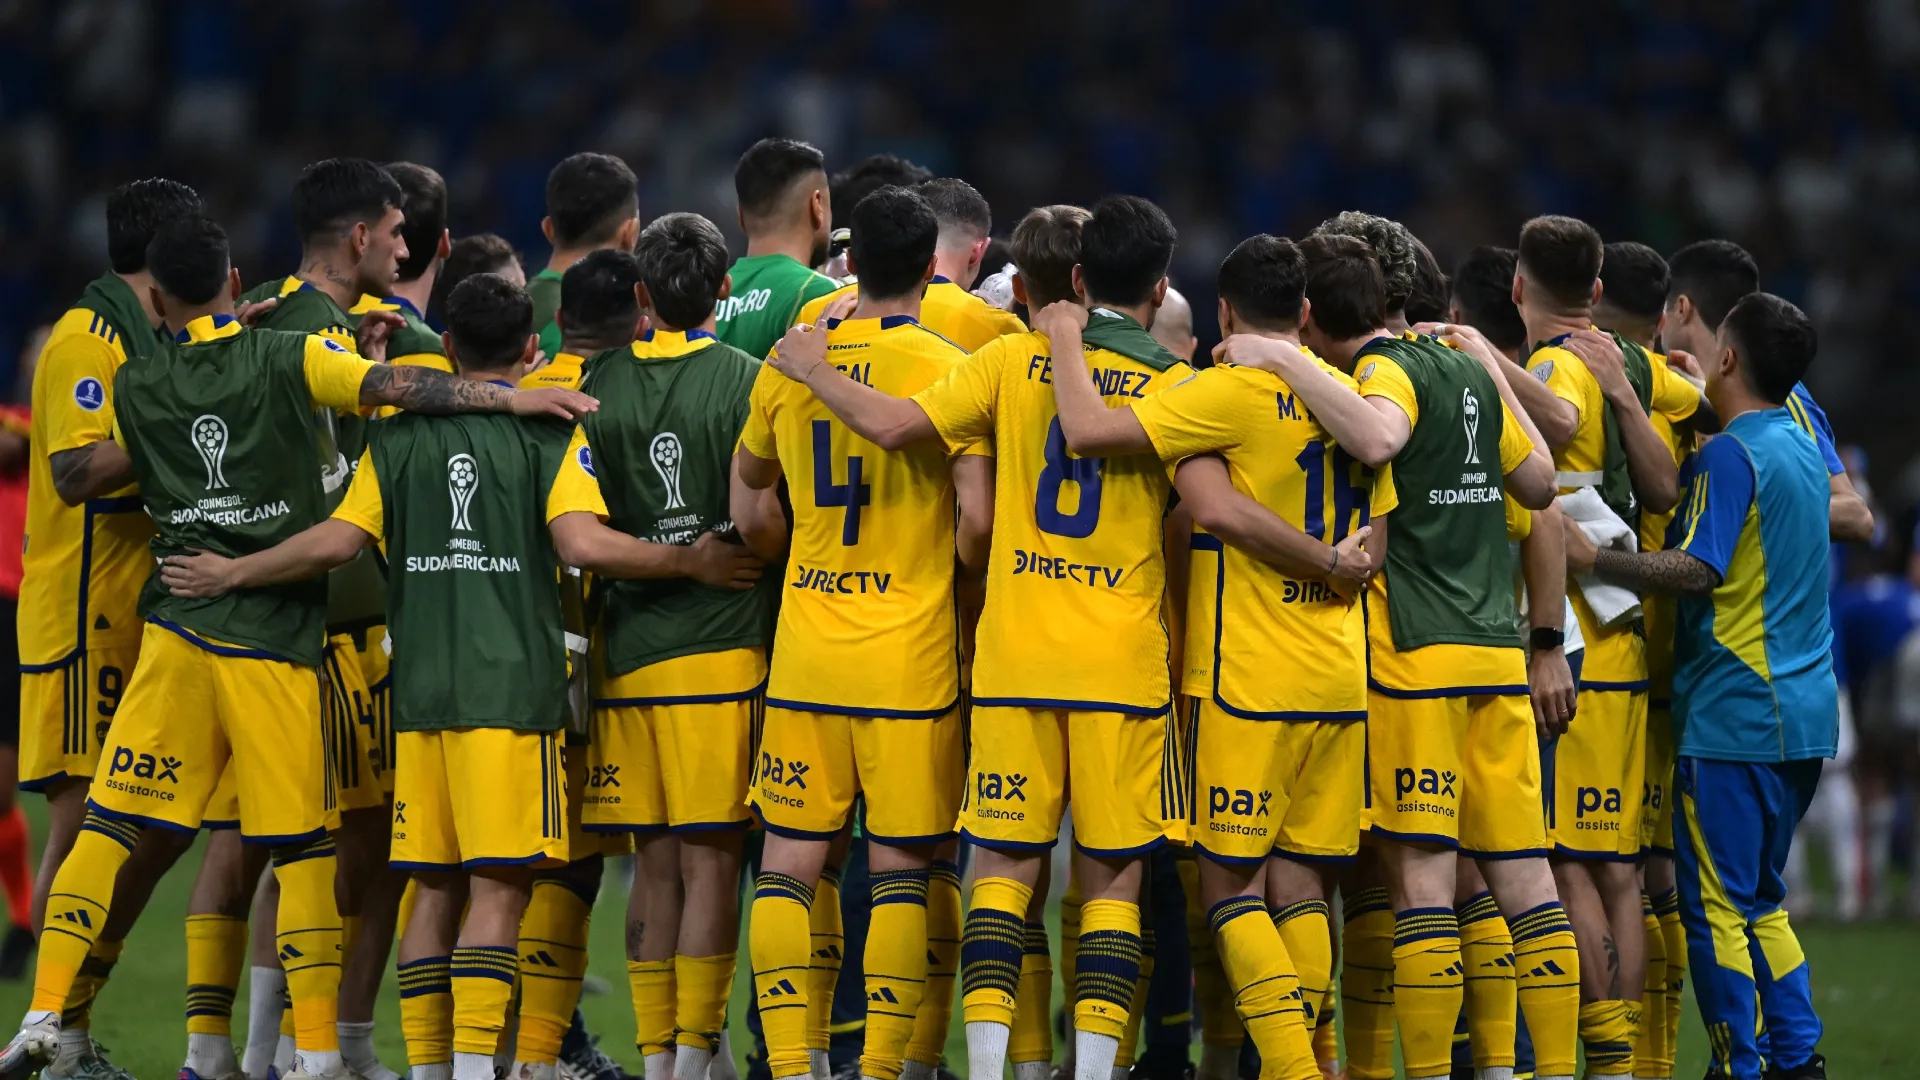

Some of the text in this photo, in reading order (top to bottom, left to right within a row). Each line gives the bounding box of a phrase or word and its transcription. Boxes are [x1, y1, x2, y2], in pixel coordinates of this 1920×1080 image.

[715, 288, 772, 322] OMERO
[1028, 354, 1152, 399] FENDEZ
[812, 420, 871, 547] 4
[1035, 412, 1106, 539] 8
[198, 494, 243, 510] CONMEBOL
[1294, 440, 1375, 547] 16
[171, 500, 290, 526] SUDAMERICANA
[658, 513, 701, 530] CONMEBOL
[791, 564, 892, 594] DIRECTV
[1012, 549, 1124, 588] DIRECTV
[97, 666, 122, 717] 9
[352, 689, 376, 740] 4
[106, 779, 175, 802] assistance
[1576, 786, 1621, 818] pa
[1396, 800, 1455, 818] assistance
[1209, 821, 1268, 837] assistance
